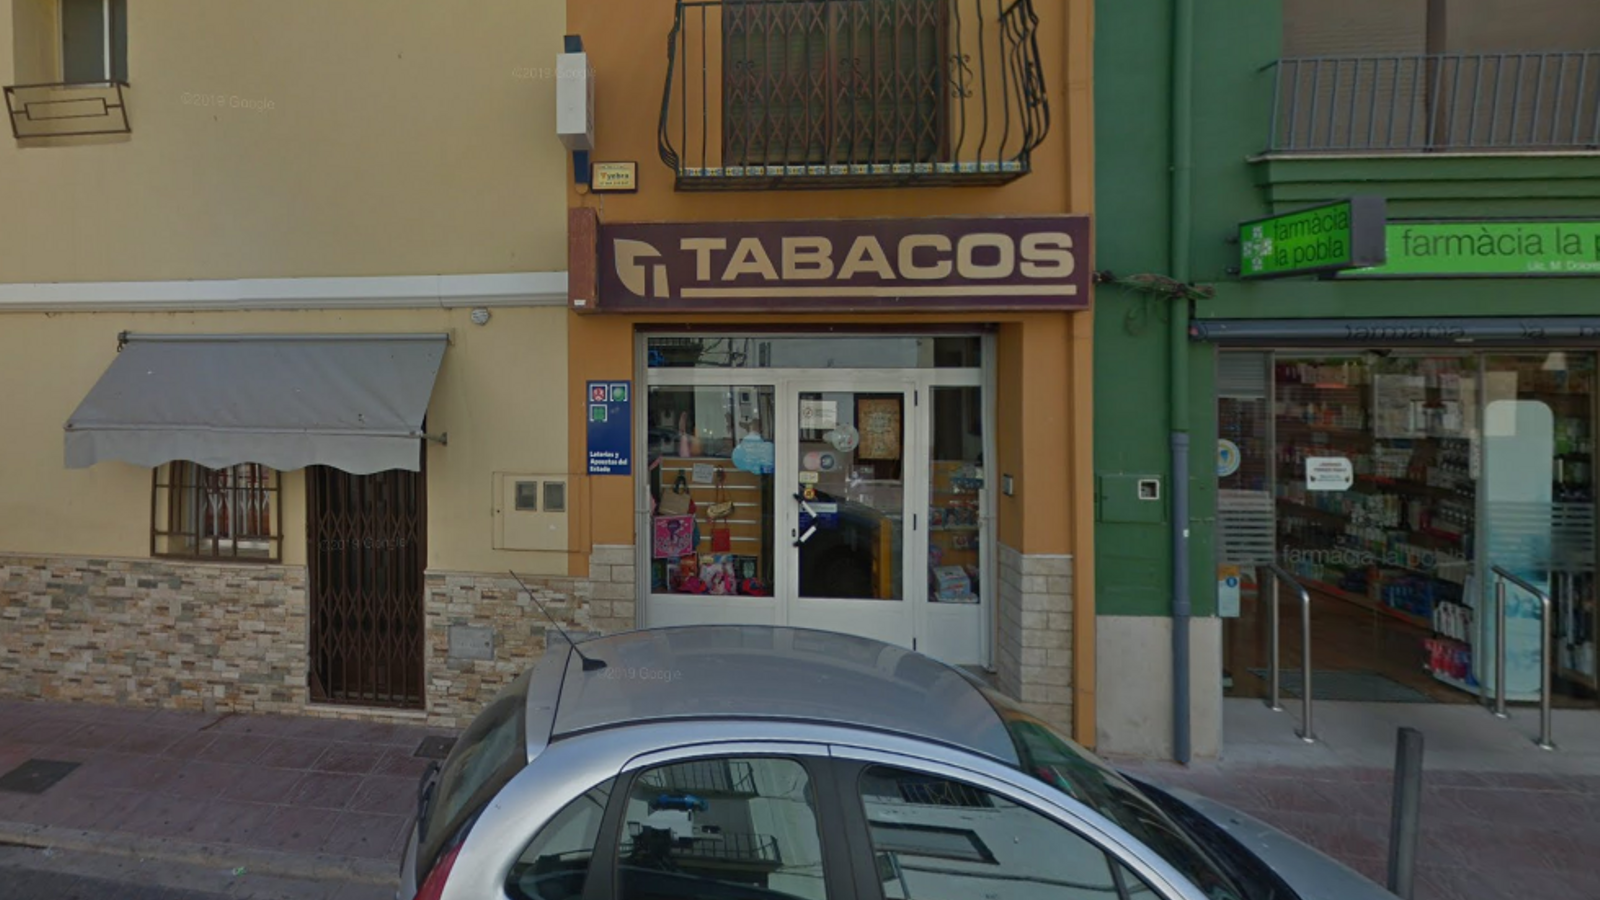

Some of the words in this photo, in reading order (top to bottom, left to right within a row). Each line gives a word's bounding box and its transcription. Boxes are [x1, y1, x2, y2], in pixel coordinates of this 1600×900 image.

[1274, 207, 1349, 241] farmàcia
[680, 232, 1076, 281] TABACOS
[1275, 246, 1289, 267] la
[1294, 236, 1345, 268] pobla
[1402, 226, 1545, 256] farmàcia
[1556, 227, 1583, 255] la
